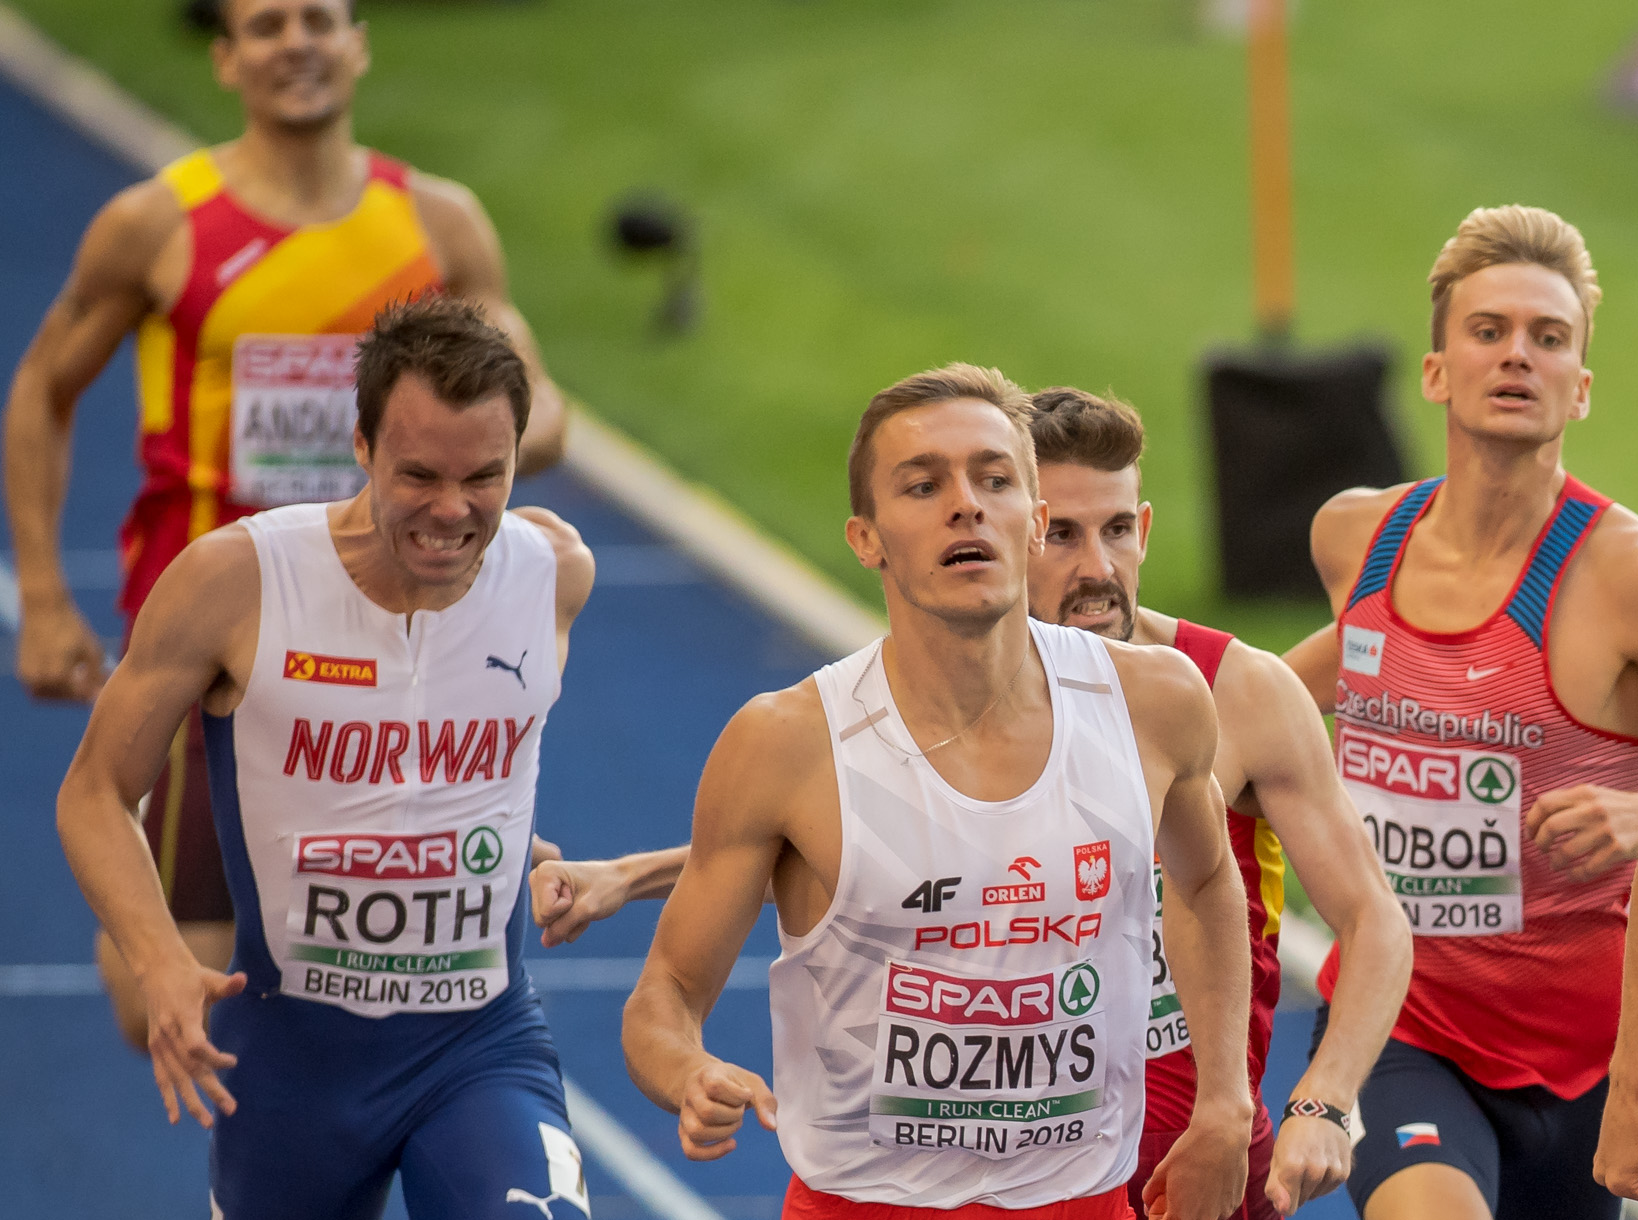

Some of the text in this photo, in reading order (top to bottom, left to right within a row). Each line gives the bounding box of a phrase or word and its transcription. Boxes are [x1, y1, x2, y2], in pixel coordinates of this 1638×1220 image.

[319, 661, 374, 680] EXTRA
[283, 714, 536, 784] NORWAY
[1345, 740, 1458, 795] SPAR
[302, 837, 454, 875] SPAR
[1076, 843, 1108, 855] POLSKA
[1364, 814, 1507, 870] ODBOĎ
[901, 876, 1042, 913] 4F ORLEN
[303, 882, 493, 945] ROTH
[914, 912, 1102, 951] POLSKA
[1431, 903, 1502, 929] 2018
[346, 952, 388, 971] RUN
[304, 967, 488, 1004] BERLIN 2018
[892, 972, 1051, 1020] SPAR
[1146, 1017, 1190, 1052] 018
[884, 1023, 1097, 1091] ROZMYS
[927, 1102, 933, 1116] I
[939, 1102, 983, 1117] RUN
[895, 1119, 1084, 1155] BERLIN 2018
